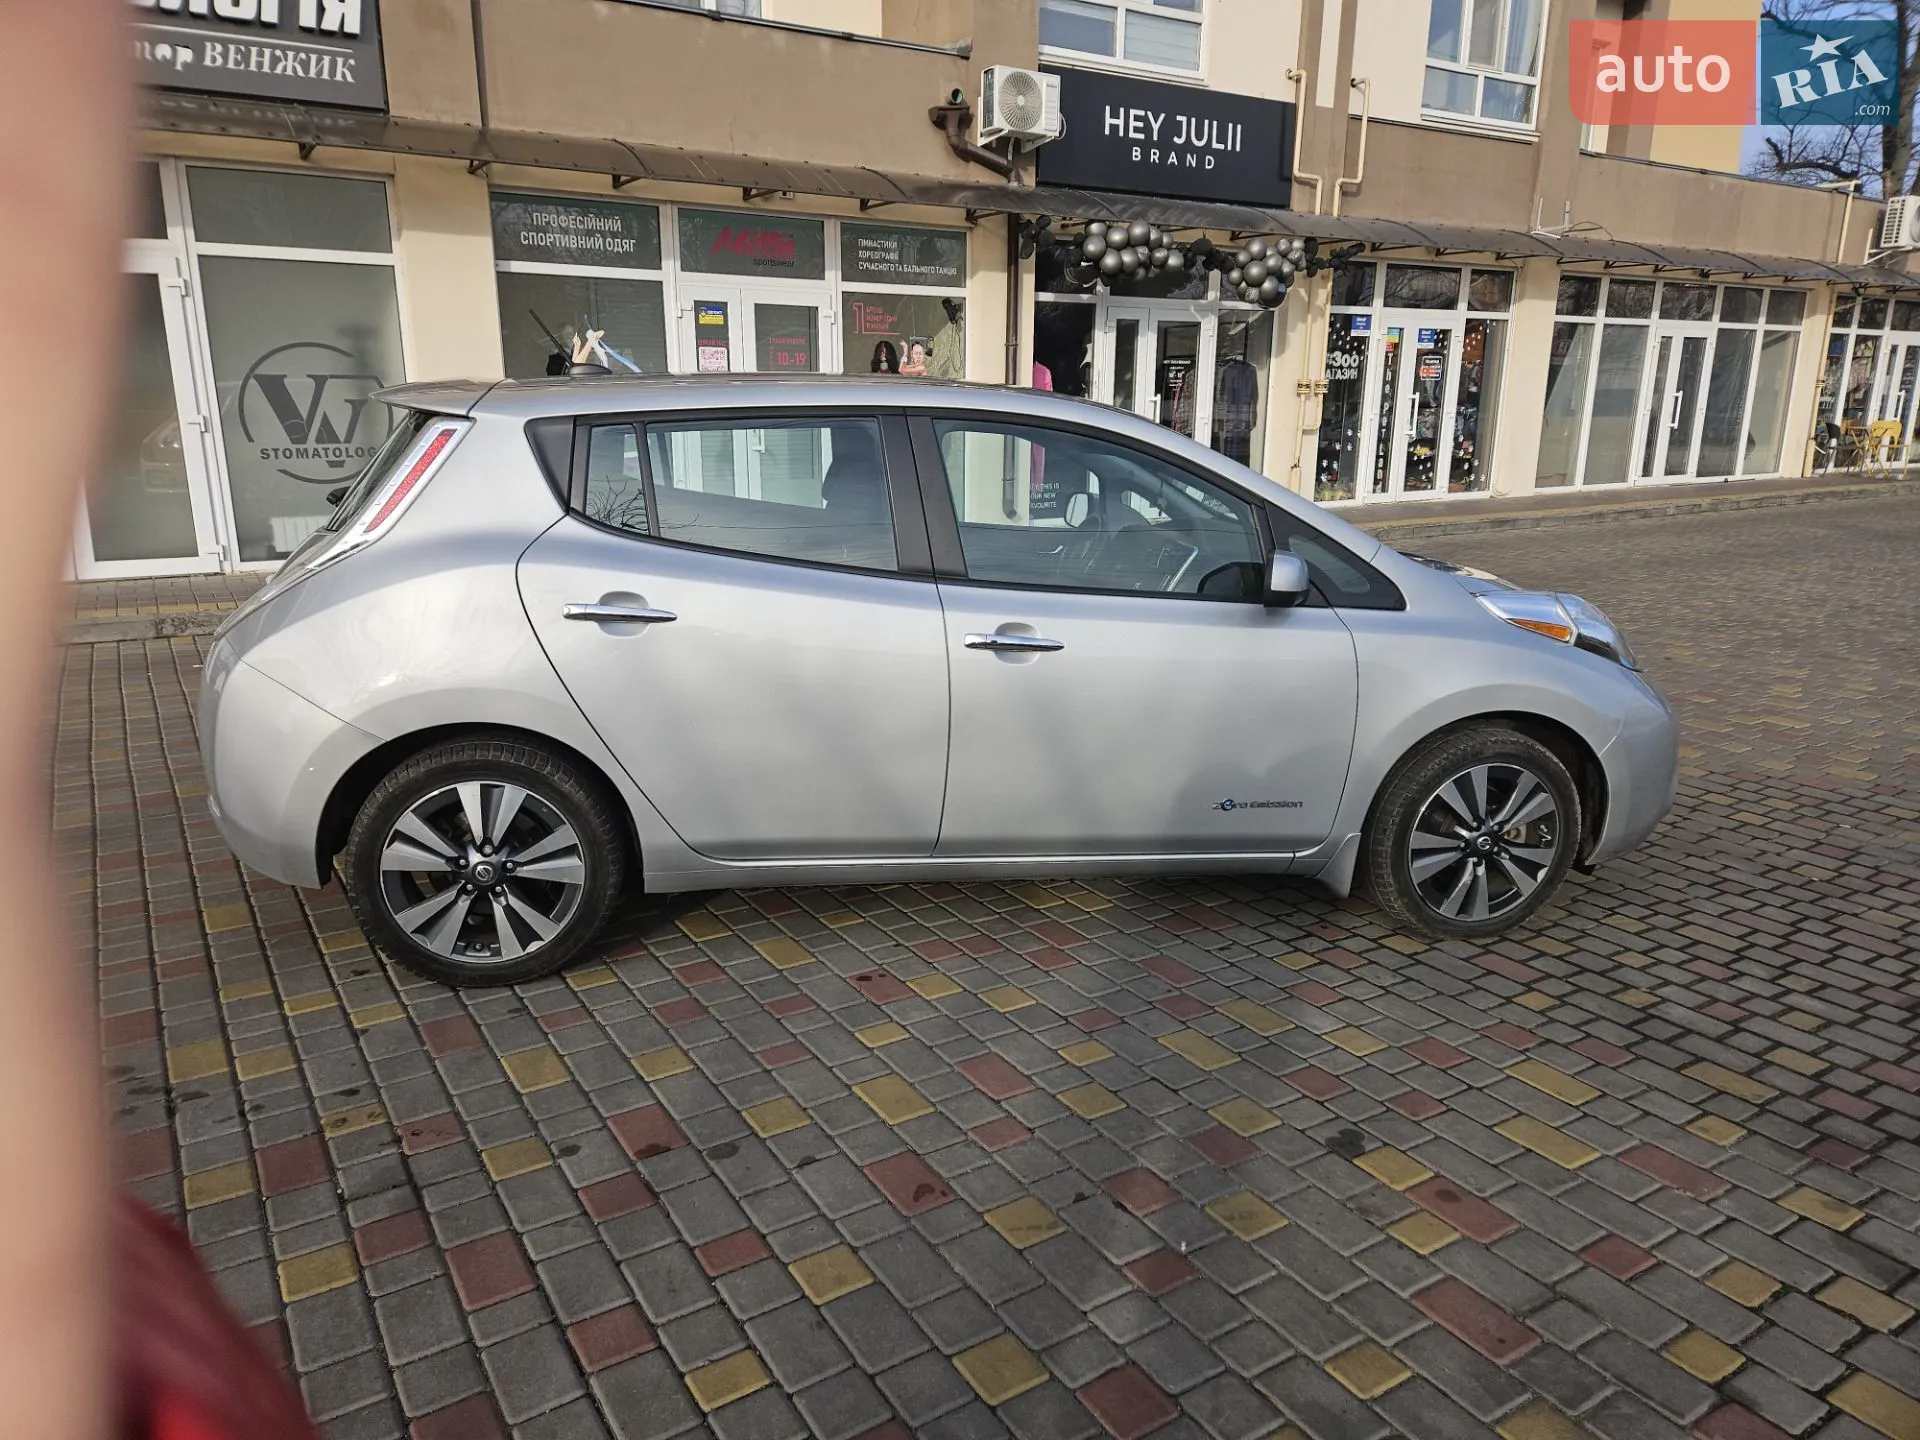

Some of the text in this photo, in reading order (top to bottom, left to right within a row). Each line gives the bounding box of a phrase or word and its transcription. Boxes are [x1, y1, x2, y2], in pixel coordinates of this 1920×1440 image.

[203, 41, 355, 83] ВЕНЖИК
[1104, 105, 1242, 152] HEY JULII
[1132, 146, 1215, 170] BRAND
[533, 212, 622, 232] ПРОФЕСІЙНИЙ
[520, 231, 636, 253] СПОРТИВНИЙ ОДЯГ
